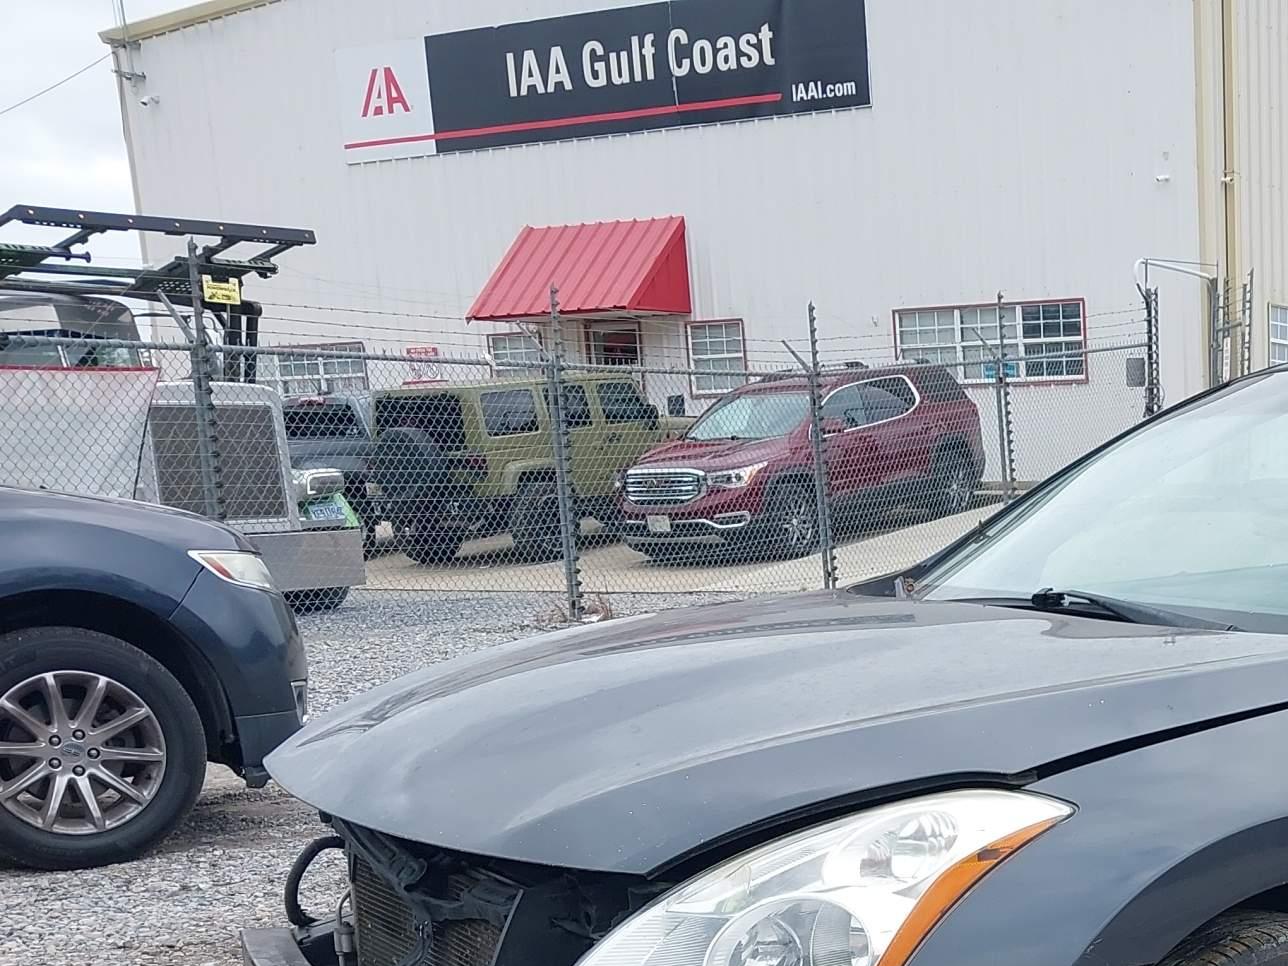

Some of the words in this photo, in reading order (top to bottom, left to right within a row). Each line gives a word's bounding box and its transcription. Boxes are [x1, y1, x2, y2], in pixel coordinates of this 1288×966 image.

[506, 45, 573, 97] IAA
[582, 33, 655, 88] Gulf
[667, 22, 776, 77] Coast
